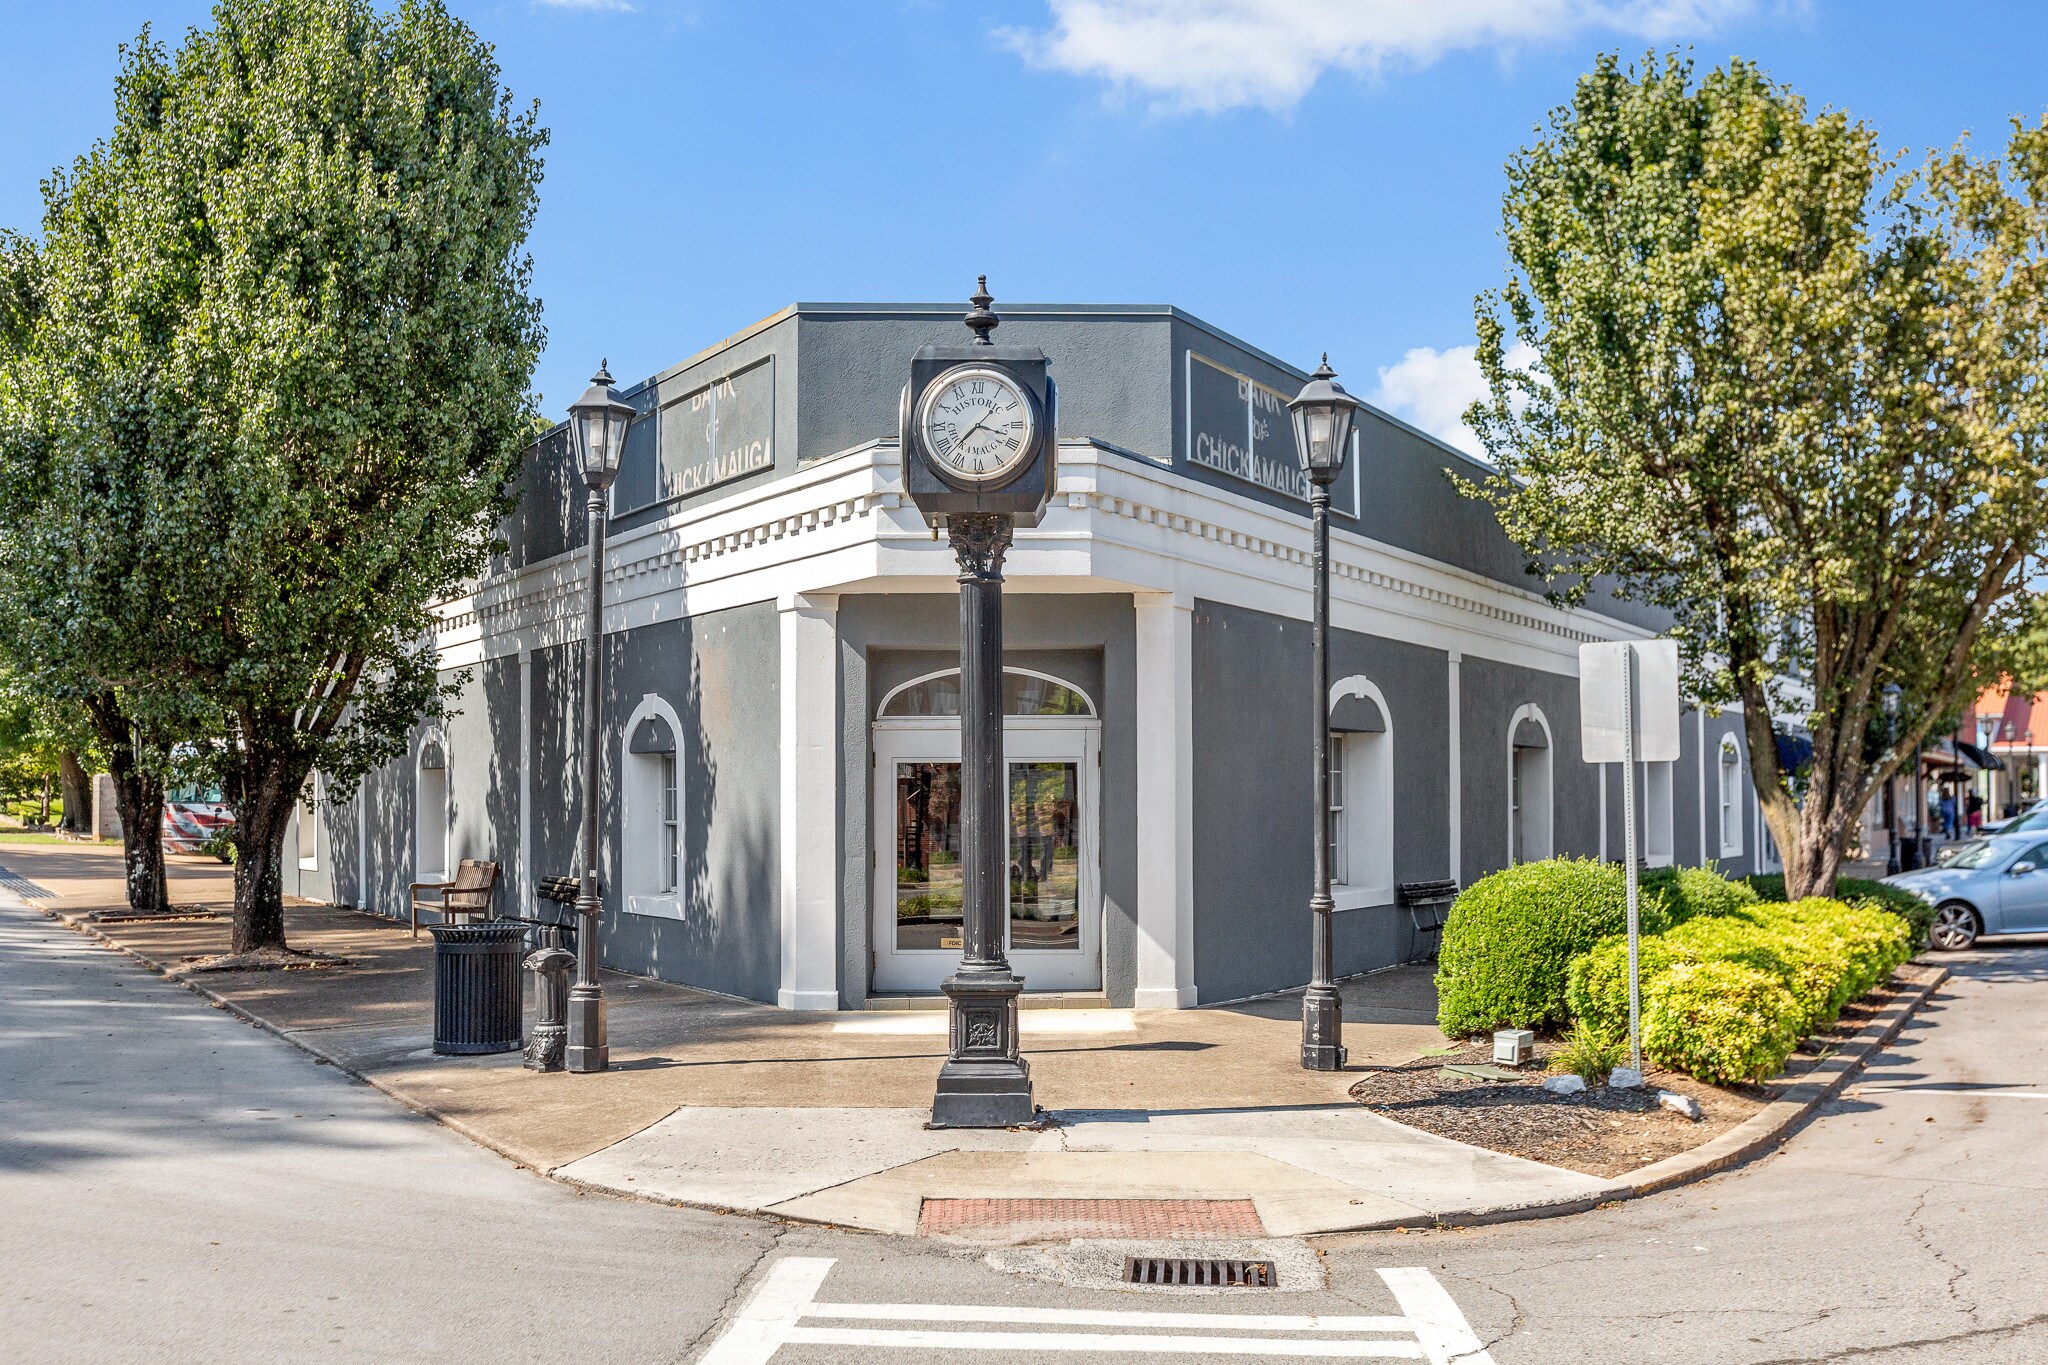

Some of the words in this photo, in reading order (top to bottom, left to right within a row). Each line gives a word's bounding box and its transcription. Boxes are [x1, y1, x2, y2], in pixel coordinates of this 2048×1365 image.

[952, 386, 965, 400] XI
[971, 381, 985, 394] XII
[938, 403, 951, 414] X
[952, 397, 1003, 415] HISTORIC
[1005, 401, 1018, 411] II
[1010, 421, 1023, 430] III
